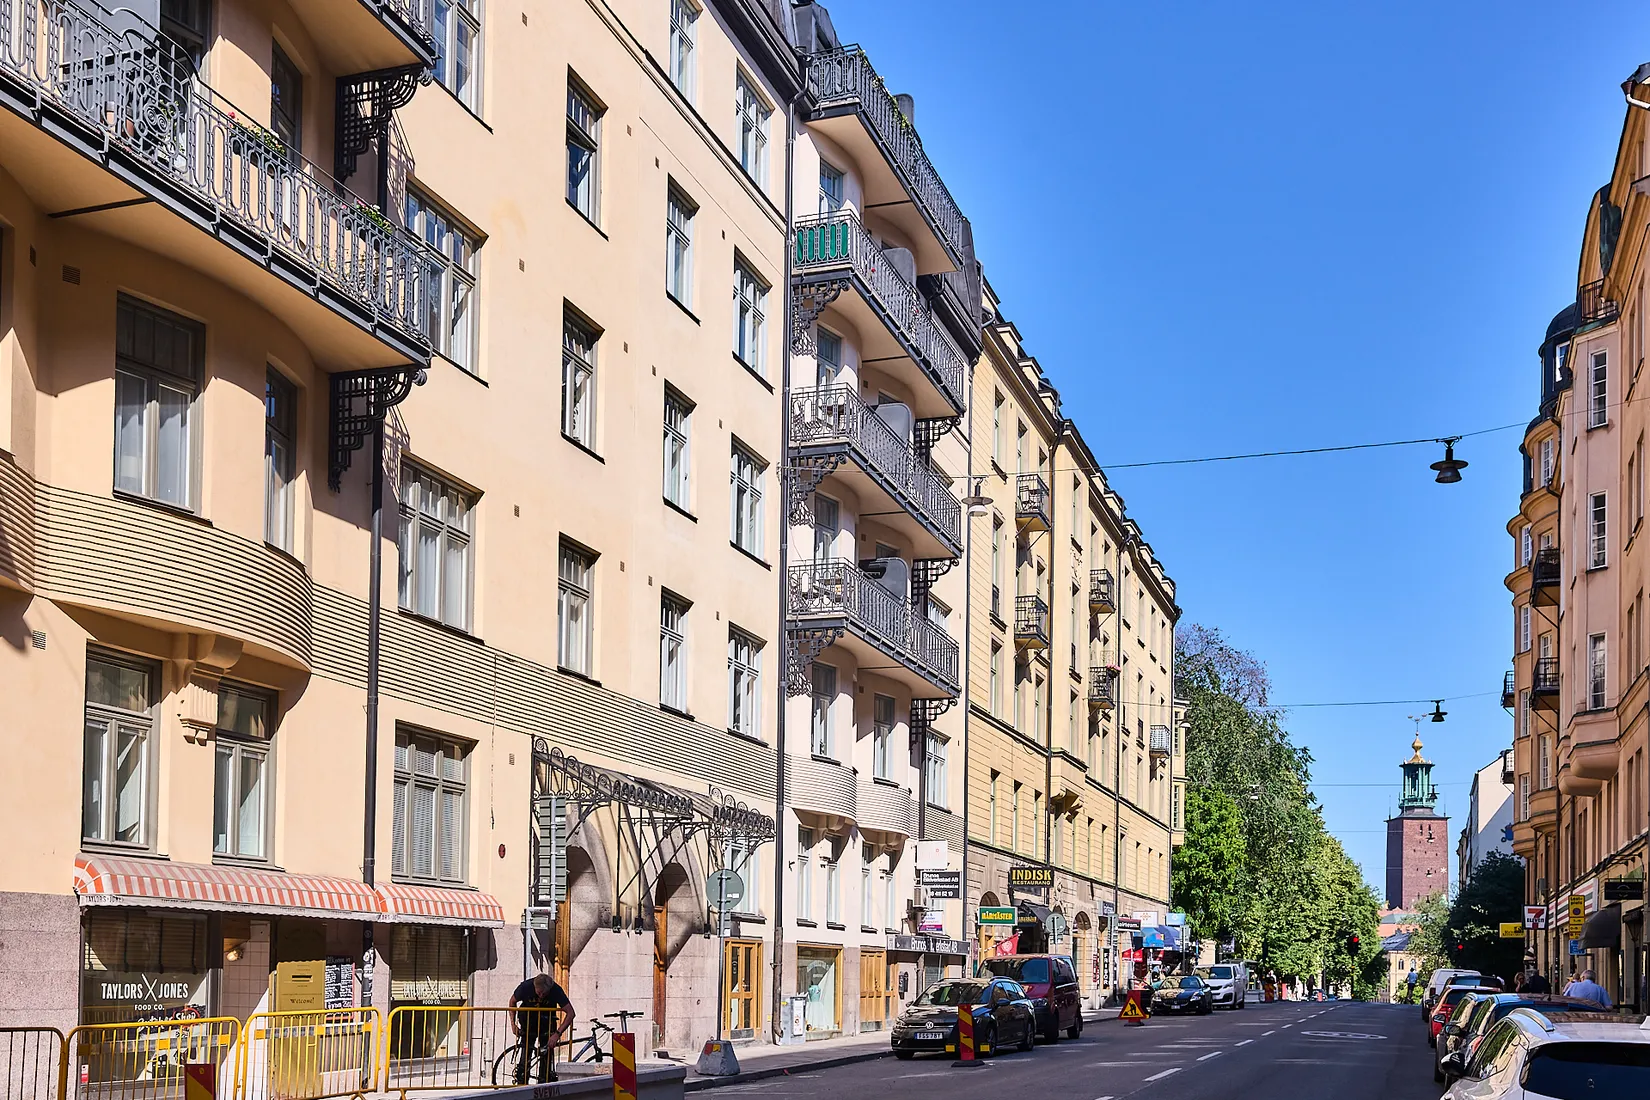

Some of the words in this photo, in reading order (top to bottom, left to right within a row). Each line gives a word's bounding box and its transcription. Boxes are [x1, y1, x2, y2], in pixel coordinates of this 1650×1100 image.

[1012, 869, 1051, 880] INDISK
[101, 983, 143, 999] TAYLORS
[158, 983, 189, 999] JONES
